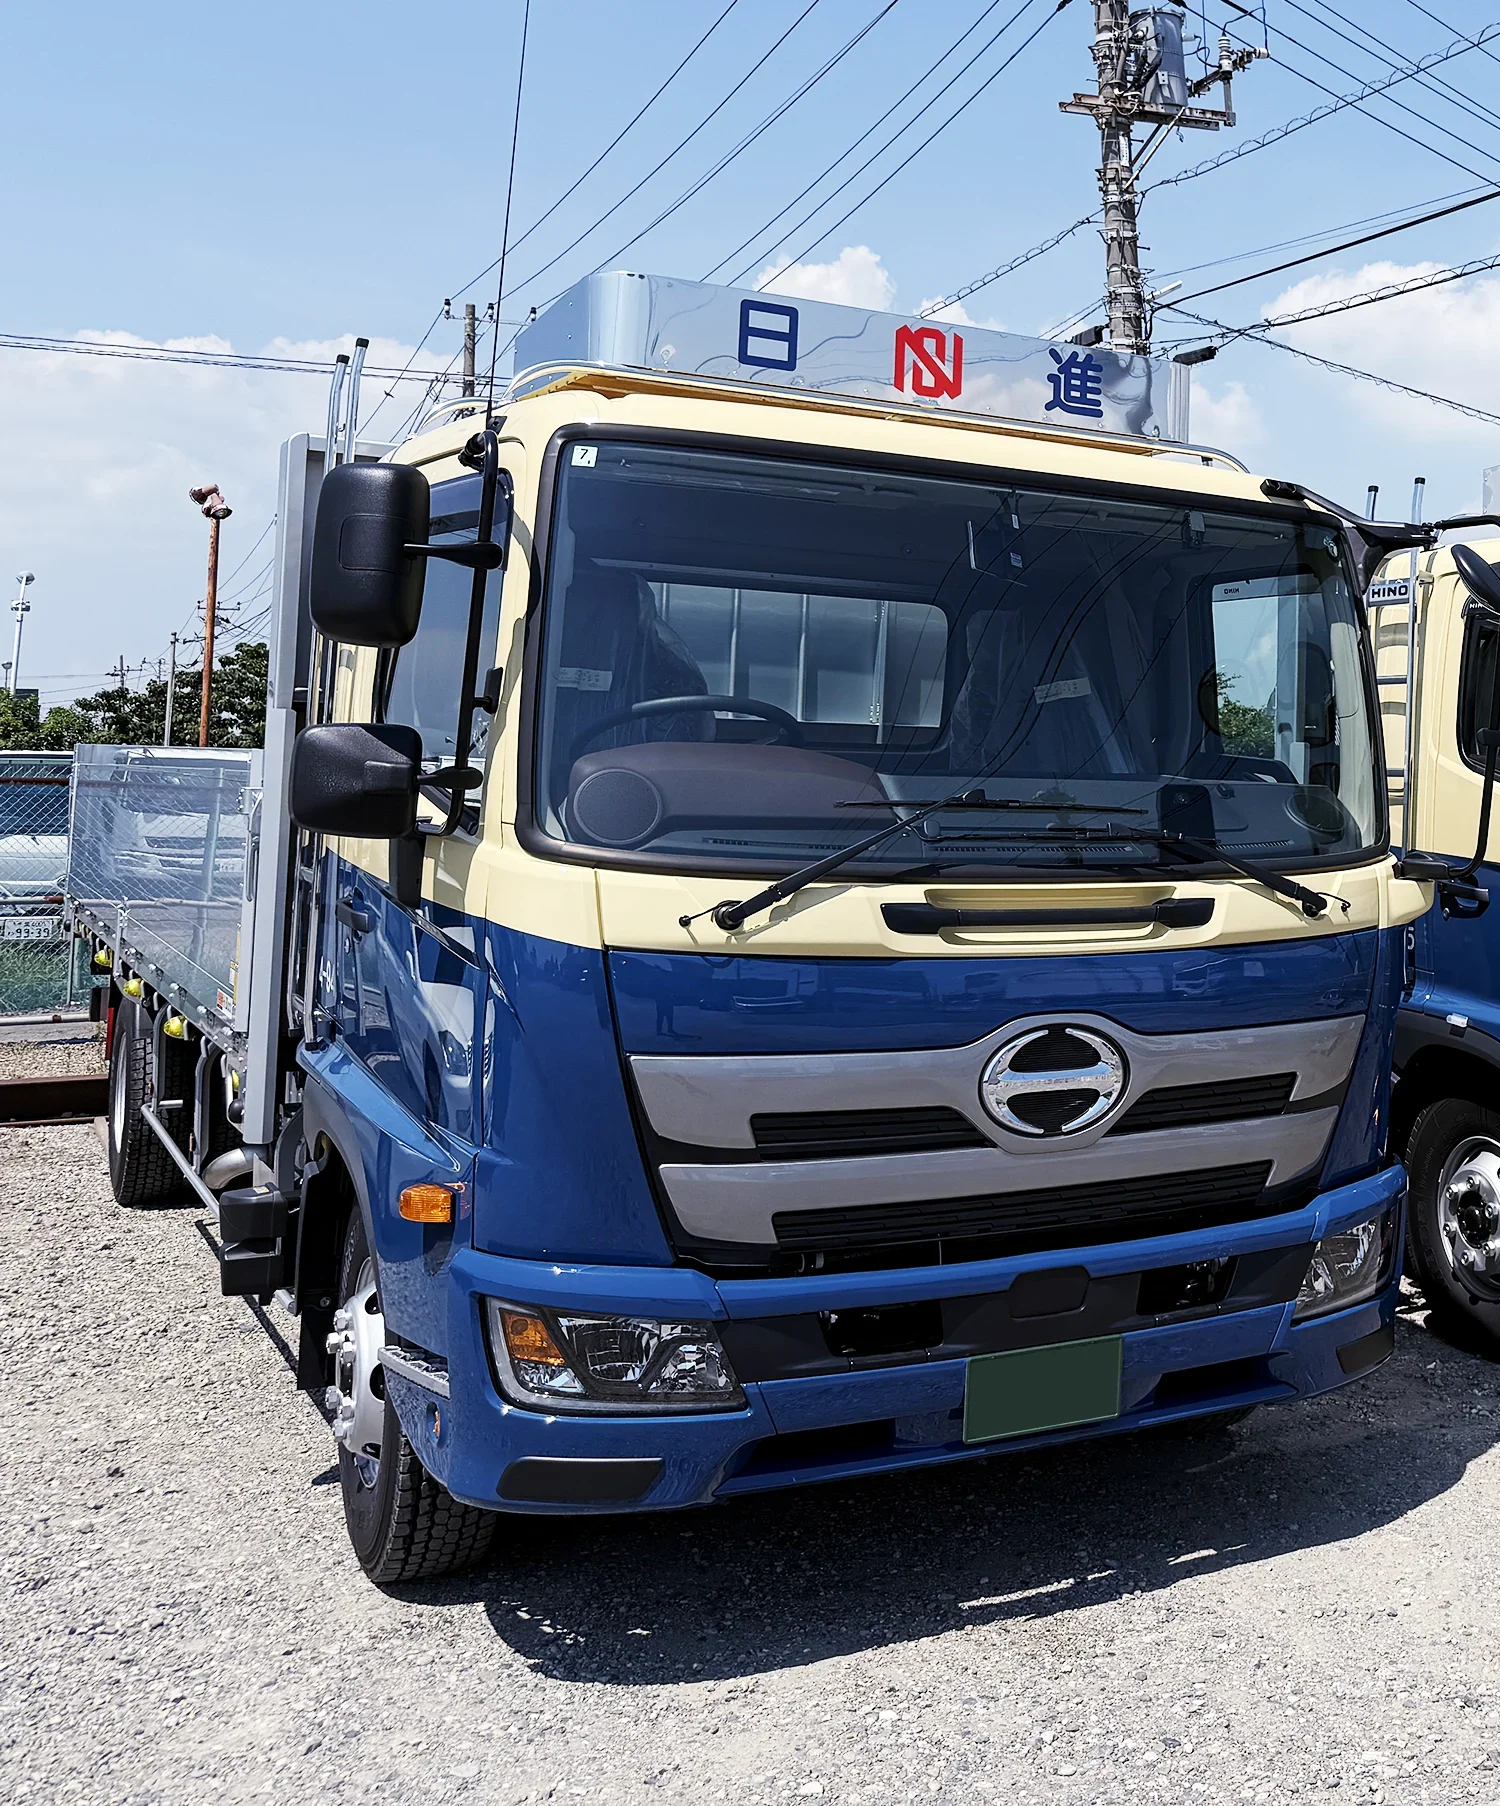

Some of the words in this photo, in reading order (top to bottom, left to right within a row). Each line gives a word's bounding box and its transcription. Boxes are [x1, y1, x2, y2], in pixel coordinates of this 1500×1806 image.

[739, 299, 799, 372] 日
[1045, 347, 1104, 418] 進
[1371, 584, 1409, 599] HINO
